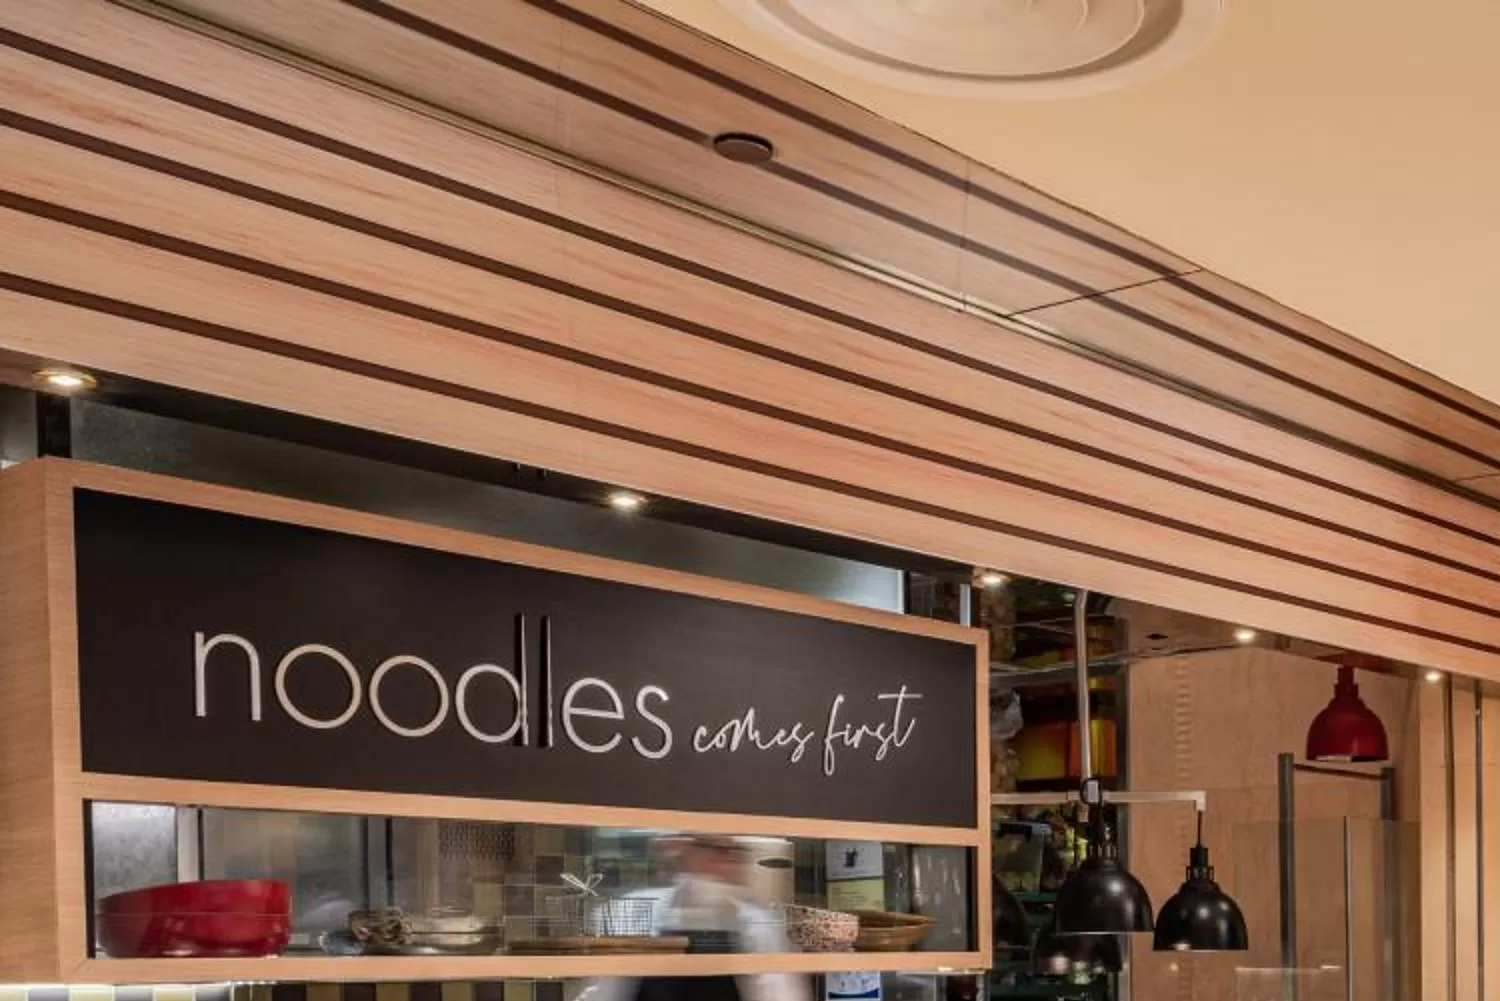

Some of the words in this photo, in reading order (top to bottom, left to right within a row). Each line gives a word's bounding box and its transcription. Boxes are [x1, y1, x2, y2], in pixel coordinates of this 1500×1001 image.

[194, 612, 672, 759] noodles
[693, 707, 815, 763] comes
[824, 685, 923, 776] first
